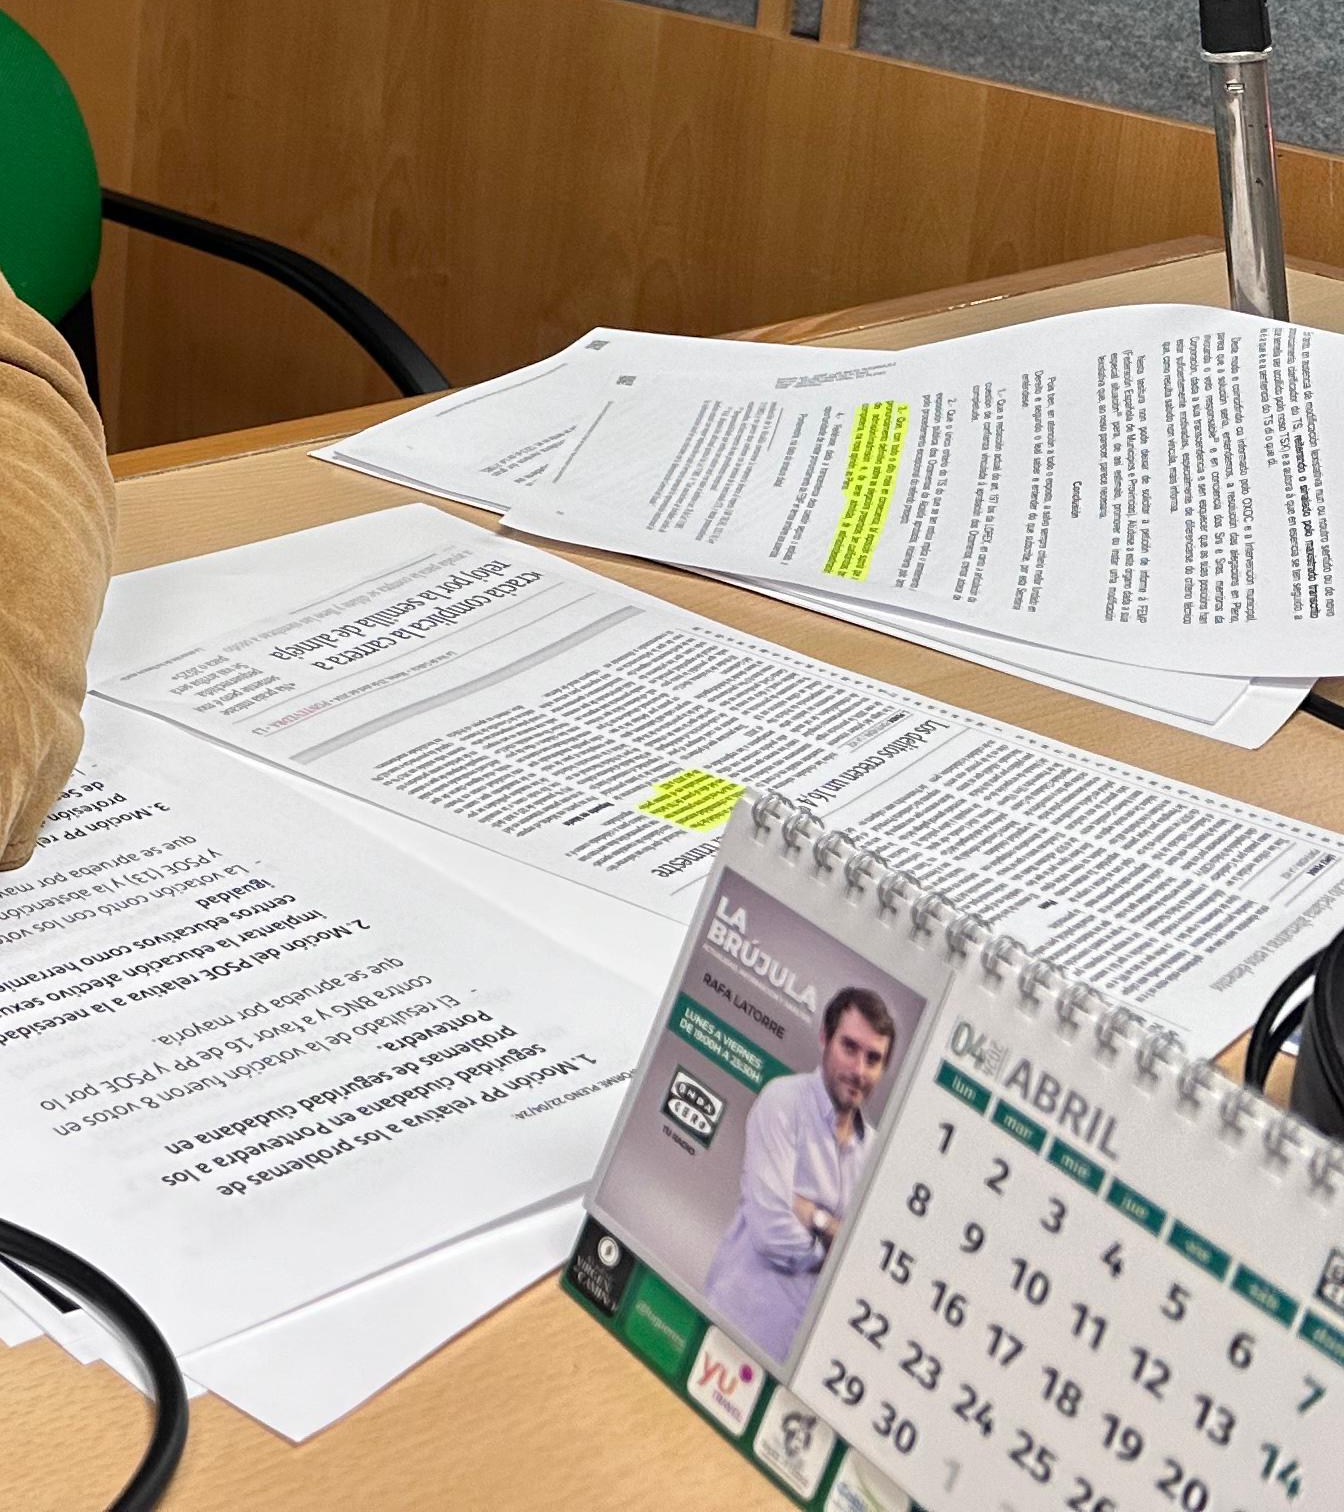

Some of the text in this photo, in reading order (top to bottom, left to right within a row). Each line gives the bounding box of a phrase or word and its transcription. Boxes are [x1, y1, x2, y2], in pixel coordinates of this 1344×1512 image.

[269, 559, 511, 660] reloj por la semilla de almeja
[408, 594, 491, 631] complica
[388, 627, 425, 639] la
[310, 660, 333, 670] a
[325, 636, 396, 665] carrera
[80, 780, 104, 791] de
[40, 792, 126, 821] profesión
[63, 827, 87, 840] PP
[36, 835, 196, 888] que se aprueba por
[160, 854, 211, 874] PSOE
[206, 847, 222, 858] y
[109, 877, 125, 888] y
[122, 867, 164, 885] (13)
[222, 864, 249, 875] La
[91, 883, 115, 893] la
[148, 872, 224, 898] votación
[194, 878, 274, 909] igualdad
[60, 909, 96, 923] con
[96, 894, 148, 916] contó
[229, 894, 295, 919] centros
[716, 896, 746, 934] LA
[31, 919, 65, 932] los
[132, 916, 229, 949] educativos
[237, 909, 326, 941] implantar
[79, 945, 132, 965] como
[214, 937, 240, 948] la
[248, 947, 280, 964] del
[122, 944, 215, 976] educación
[198, 957, 253, 980] PSOE
[708, 920, 817, 1011] BRÚJULA
[45, 973, 121, 1001] afectivo
[110, 997, 127, 1006] a
[126, 973, 199, 1001] relativa
[157, 957, 403, 1045] que se aprueba por mayoría.
[89, 1001, 115, 1013] la
[702, 972, 785, 1039] RAFA LATORRE
[39, 975, 431, 1110] contra BNG y a favor 16 de PP y PSOE por lo
[376, 1009, 492, 1051] Pontevedra.
[679, 1017, 693, 1034] DE
[721, 1050, 729, 1061] A
[684, 1007, 761, 1069] LUNES A VIERNES
[52, 994, 460, 1136] El resultado de la votación fueron 8 votos en
[163, 1024, 516, 1154] problemas de seguridad ciudadana en
[480, 1086, 508, 1102] PP
[676, 1080, 714, 1116] ONDA
[950, 1021, 1116, 1159] 04 ABRIL
[160, 1043, 545, 1186] seguridad ciudadana en Pontevedra a los
[401, 1096, 476, 1127] relativa
[671, 1096, 708, 1134] CERO
[353, 1129, 392, 1145] los
[384, 1123, 402, 1133] a
[246, 1138, 354, 1185] problemas
[216, 1180, 246, 1195] de
[940, 1122, 1325, 1413] 1 2 3 4 5 6 7
[907, 1183, 1300, 1498] 8 9 10 11 12 13 14
[881, 1240, 1208, 1512] 15 16 17 18 19 20
[849, 1299, 889, 1349] 22
[900, 1340, 942, 1390] 23
[953, 1384, 992, 1436] 24
[1009, 1429, 1054, 1483] 25
[824, 1359, 917, 1454] 29 30
